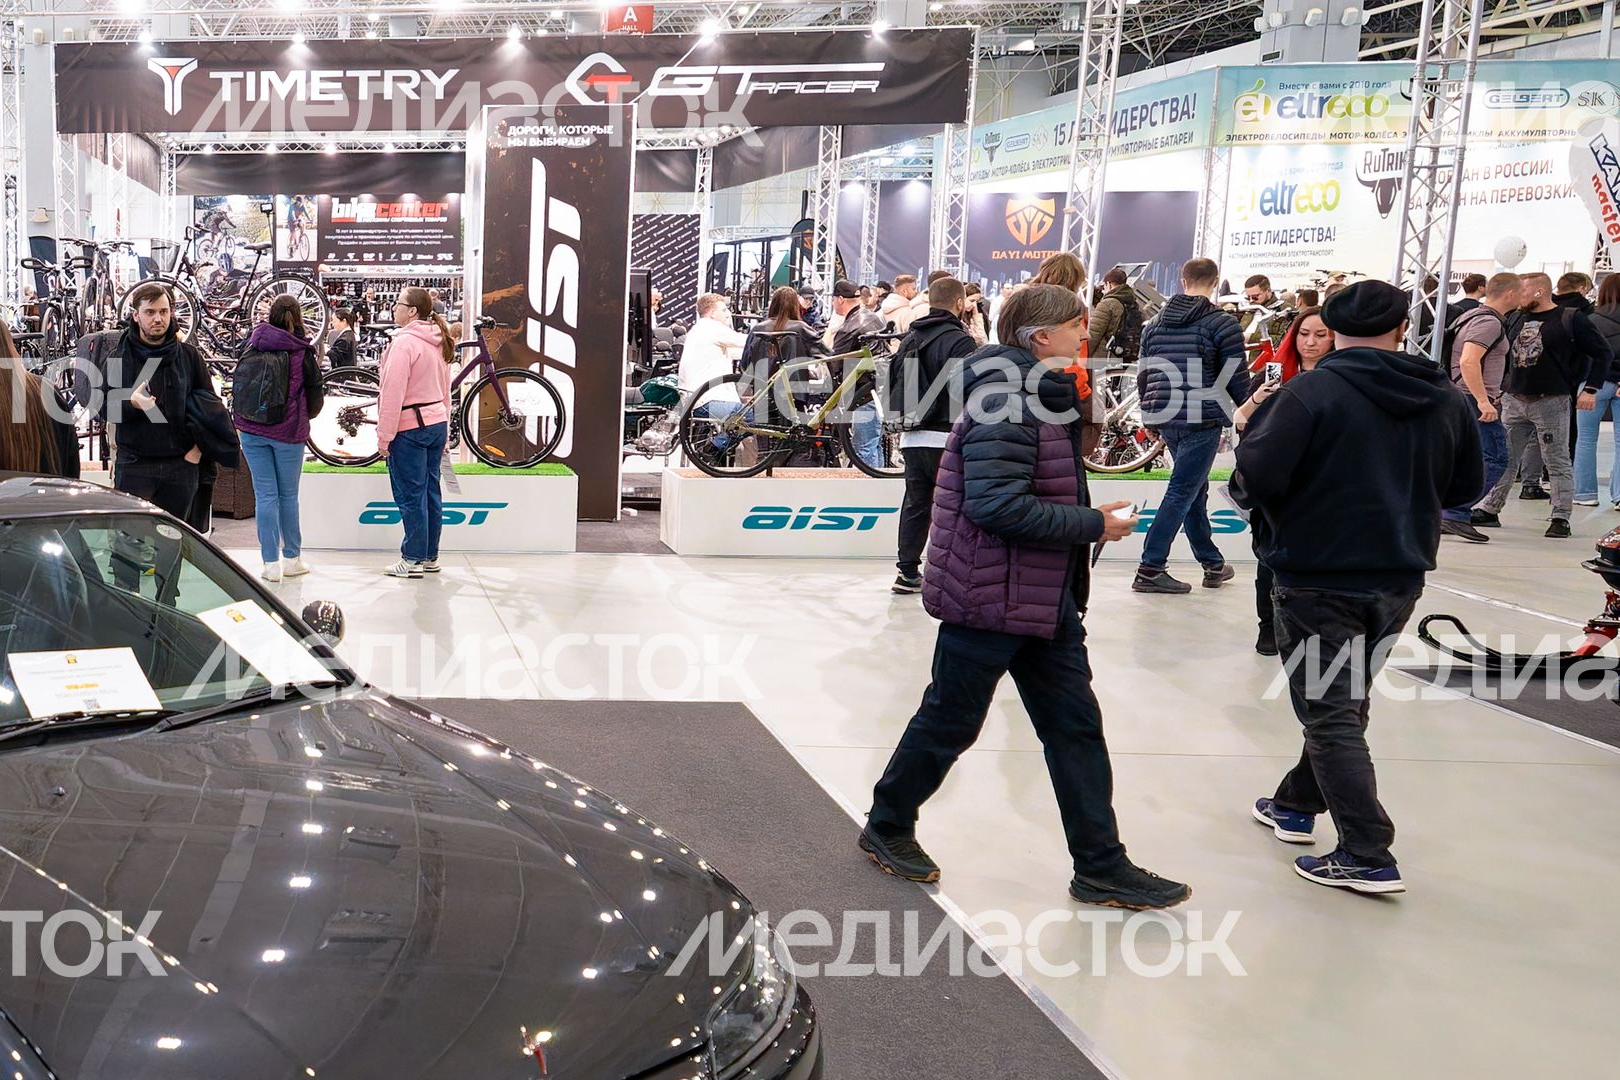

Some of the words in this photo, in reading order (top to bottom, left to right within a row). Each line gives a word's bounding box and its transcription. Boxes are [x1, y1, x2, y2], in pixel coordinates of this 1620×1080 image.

[623, 6, 638, 22] A
[209, 68, 460, 101] TIMETRY
[1276, 92, 1390, 119] eltreco
[507, 126, 556, 136] ДОРОГИ,
[558, 125, 614, 135] КОТОРЫЕ
[1053, 122, 1067, 146] 15
[507, 137, 527, 147] МЫ
[529, 137, 591, 146] ВЫБИРАЕМ
[1494, 159, 1554, 178] РОССИИ!
[1259, 179, 1342, 217] eltreco
[1230, 232, 1241, 246] 15
[1242, 230, 1263, 246] ЛЕТ
[1264, 226, 1336, 247] ЛИДЕРСТВА!
